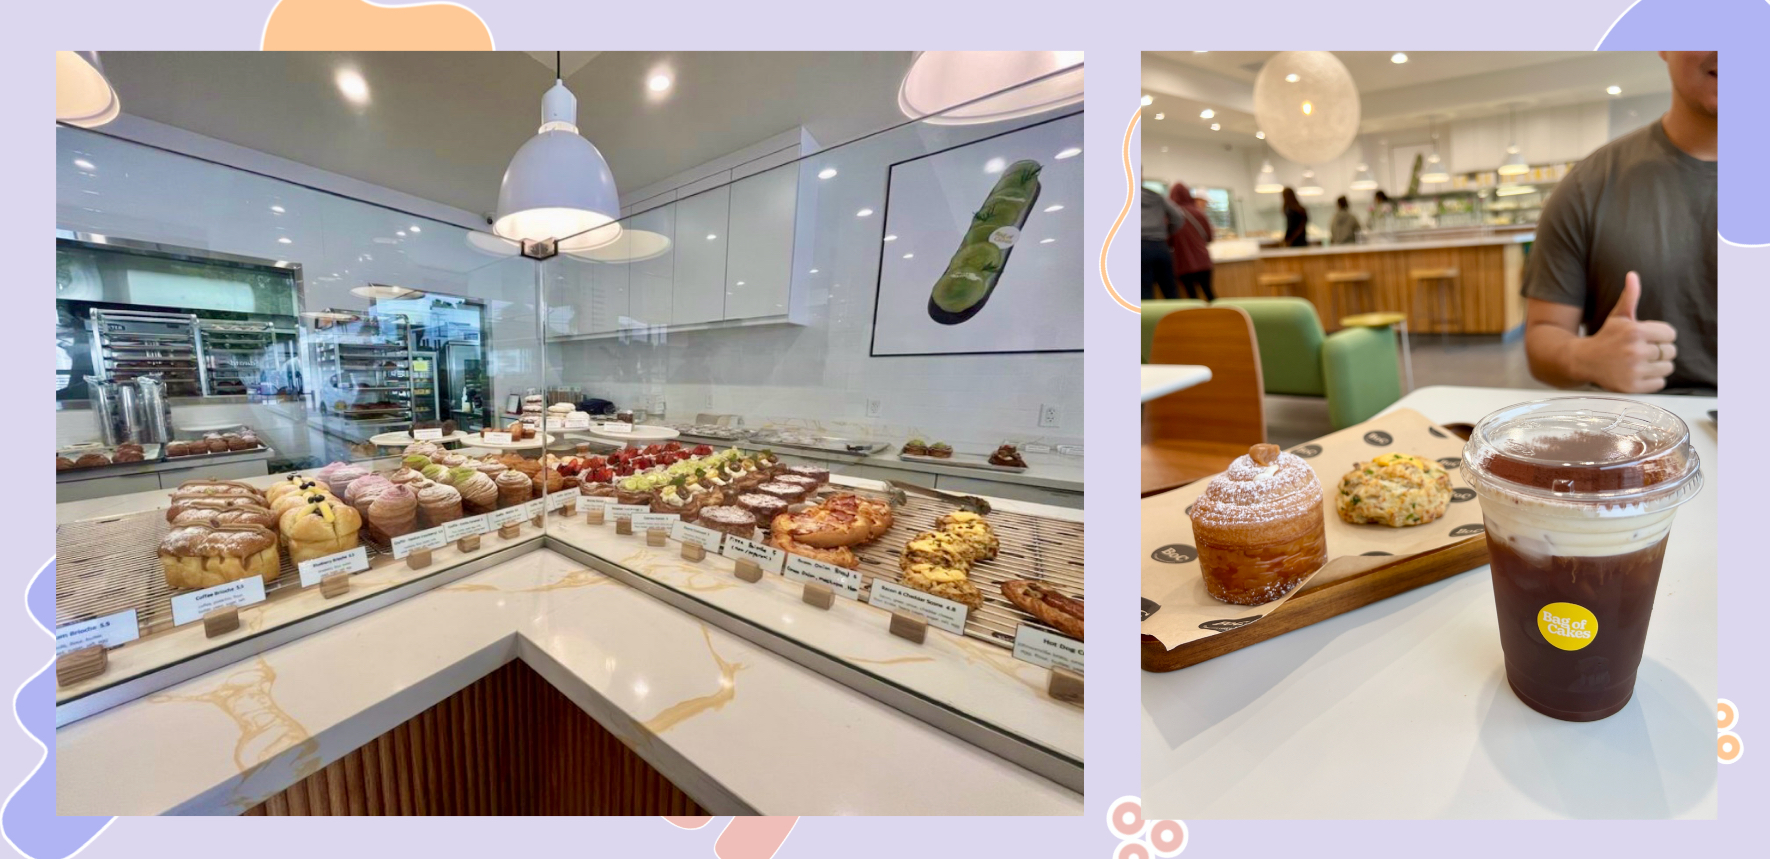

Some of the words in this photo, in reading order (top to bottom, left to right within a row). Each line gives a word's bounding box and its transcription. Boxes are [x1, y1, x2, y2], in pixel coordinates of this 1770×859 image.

[1161, 547, 1189, 562] BoC
[195, 593, 214, 601] Coffee
[214, 587, 235, 597] Brioche
[881, 585, 897, 594] Bacon
[903, 592, 925, 602] Cheddar
[926, 599, 944, 608] Scone
[1543, 610, 1570, 629] Bag
[1572, 619, 1587, 630] of
[69, 625, 97, 637] Brioche
[1547, 623, 1591, 639] Cakes
[1043, 638, 1057, 647] Hot
[1059, 643, 1076, 654] Dog
